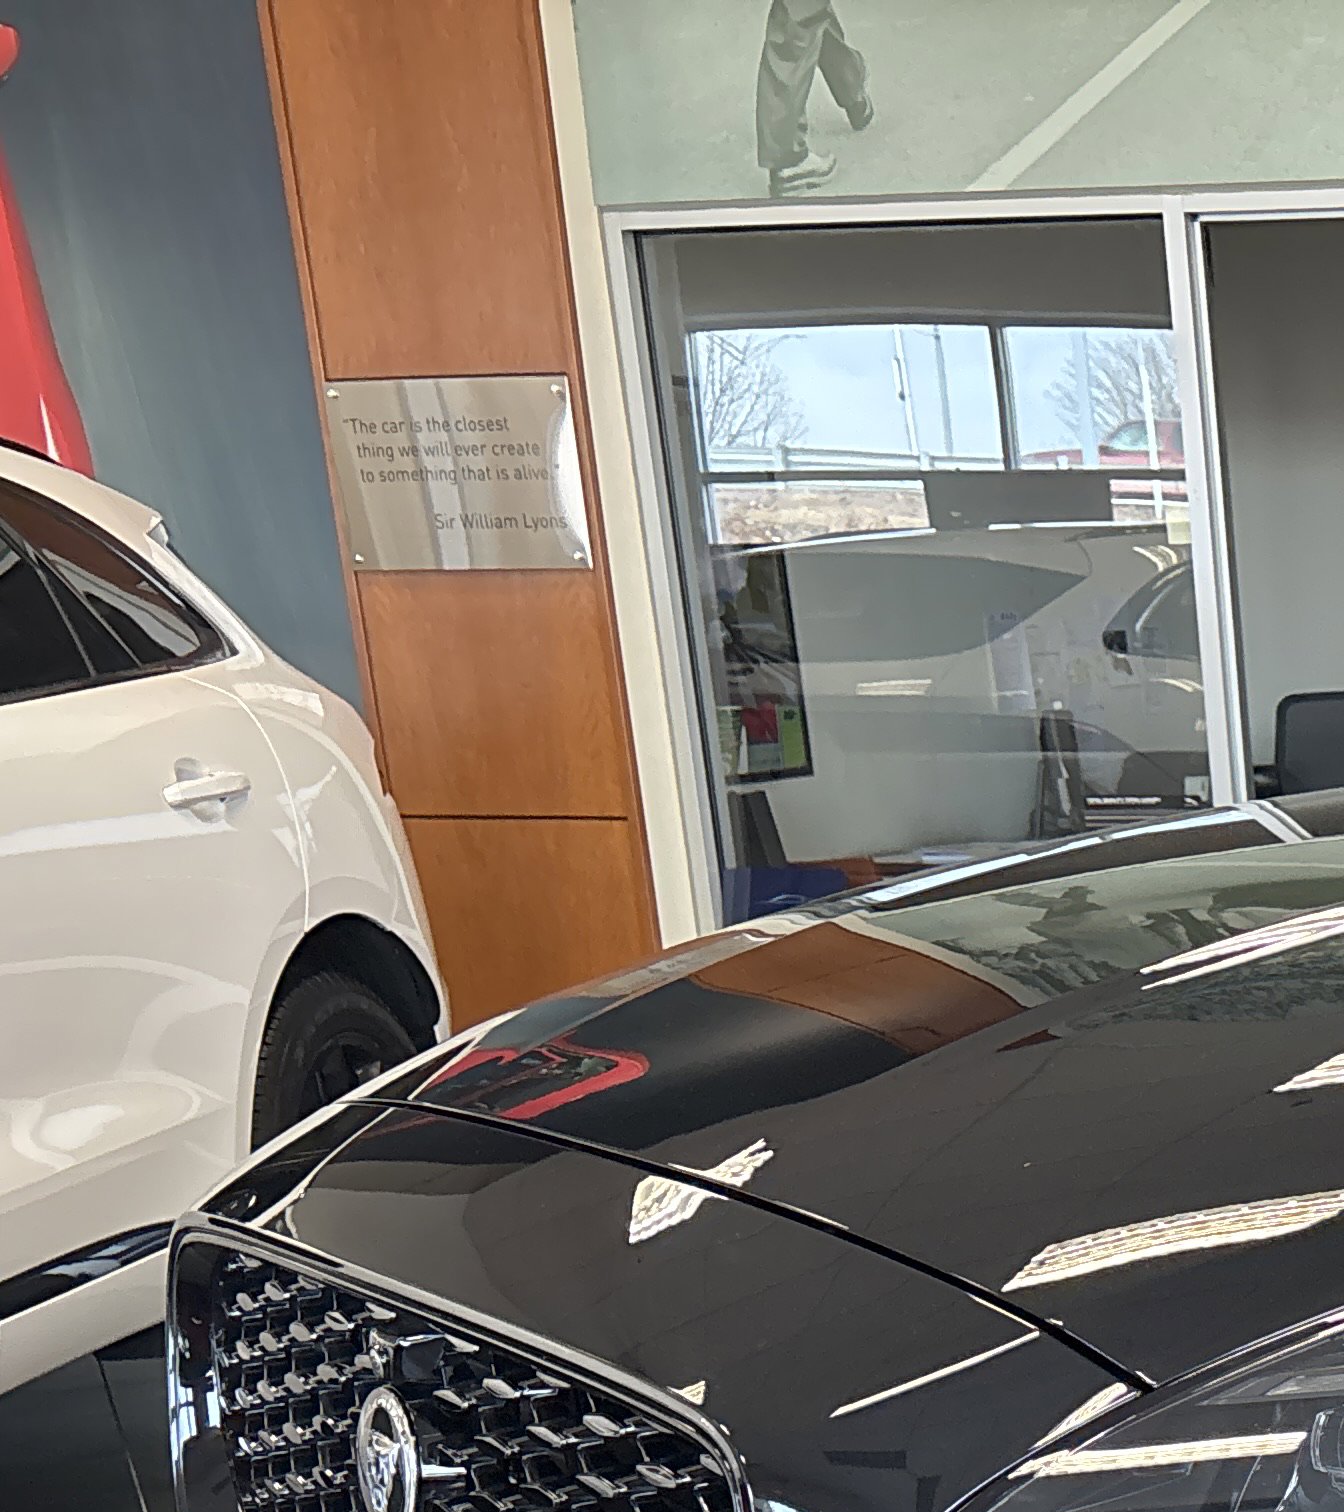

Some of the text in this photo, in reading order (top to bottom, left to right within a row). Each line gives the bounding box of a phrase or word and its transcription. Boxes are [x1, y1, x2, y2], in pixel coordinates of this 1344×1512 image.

[381, 421, 404, 434] car
[410, 419, 422, 433] is
[426, 418, 451, 432] the
[455, 416, 509, 432] closest
[357, 441, 540, 462] thing we will ever create
[360, 469, 375, 483] to
[379, 467, 457, 485] something
[462, 466, 490, 481] that
[496, 466, 509, 481] is
[434, 513, 568, 532] Sir William Lyons
